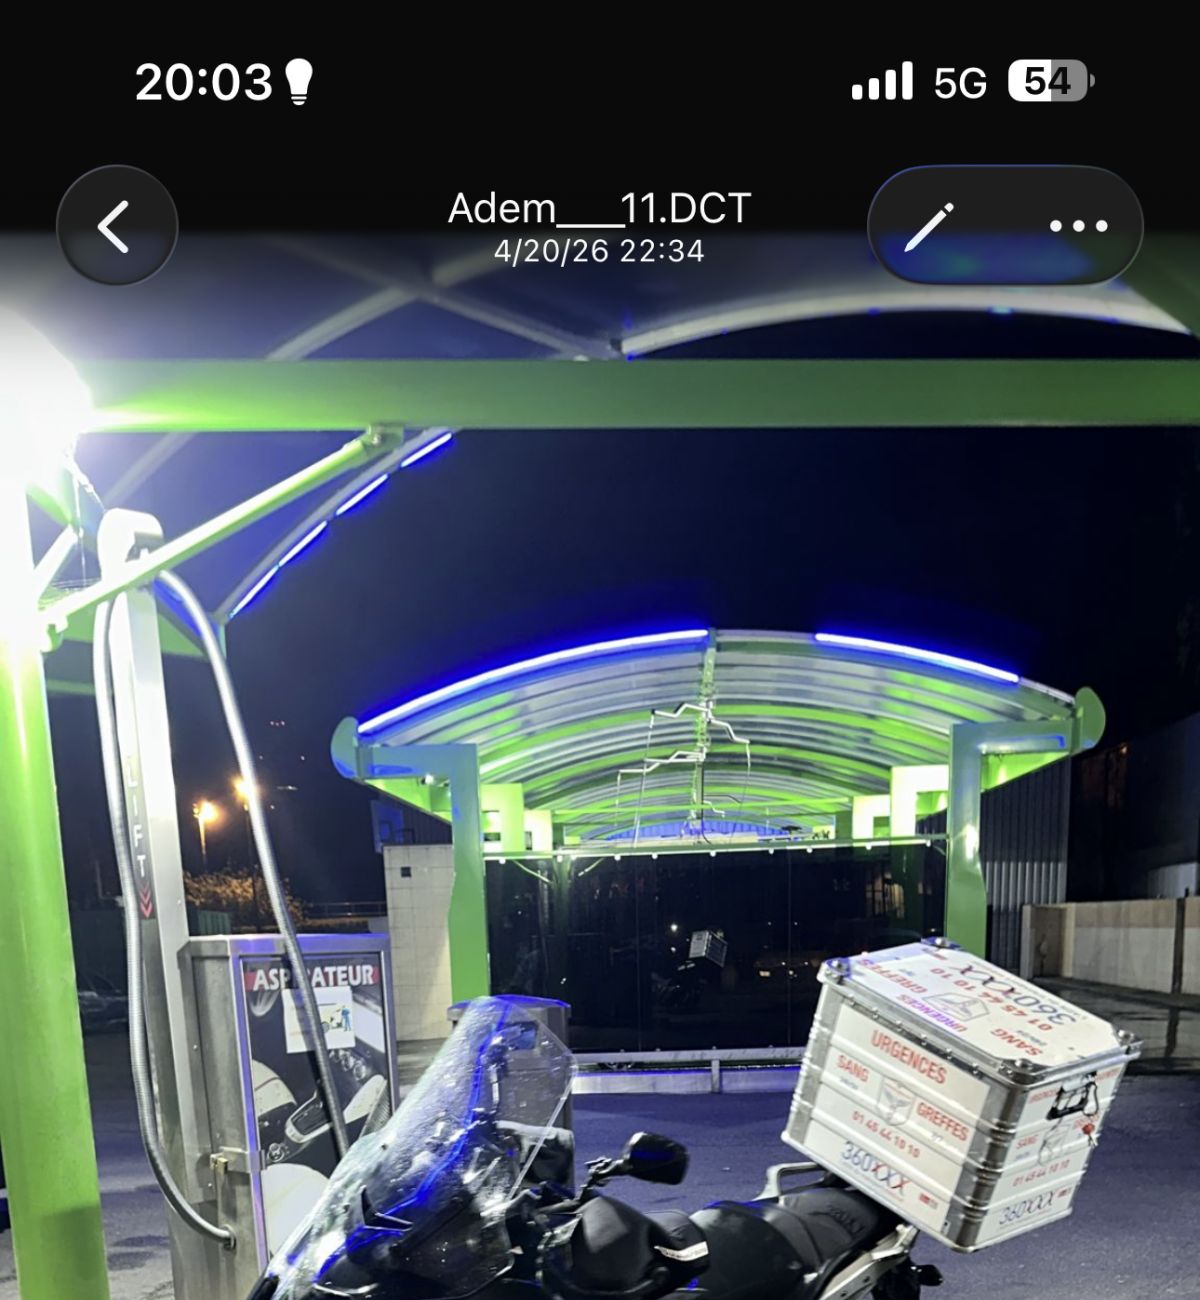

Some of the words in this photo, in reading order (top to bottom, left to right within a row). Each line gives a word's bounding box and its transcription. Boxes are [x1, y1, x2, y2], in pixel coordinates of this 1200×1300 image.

[126, 764, 147, 878] LIFT
[253, 965, 374, 991] ASPATEUR
[859, 959, 928, 994] GREFFES
[930, 967, 953, 980] 10
[954, 979, 976, 992] 10
[896, 994, 968, 1033] URGENCES
[1003, 1005, 1027, 1017] 45
[1028, 1018, 1052, 1031] 01
[991, 1027, 1043, 1056] SANG
[837, 1055, 870, 1083] SANG
[870, 1029, 948, 1084] URGENCES
[852, 1111, 865, 1124] 01
[895, 1135, 906, 1150] 10
[908, 1144, 921, 1158] 10
[916, 1102, 970, 1142] GREFFES
